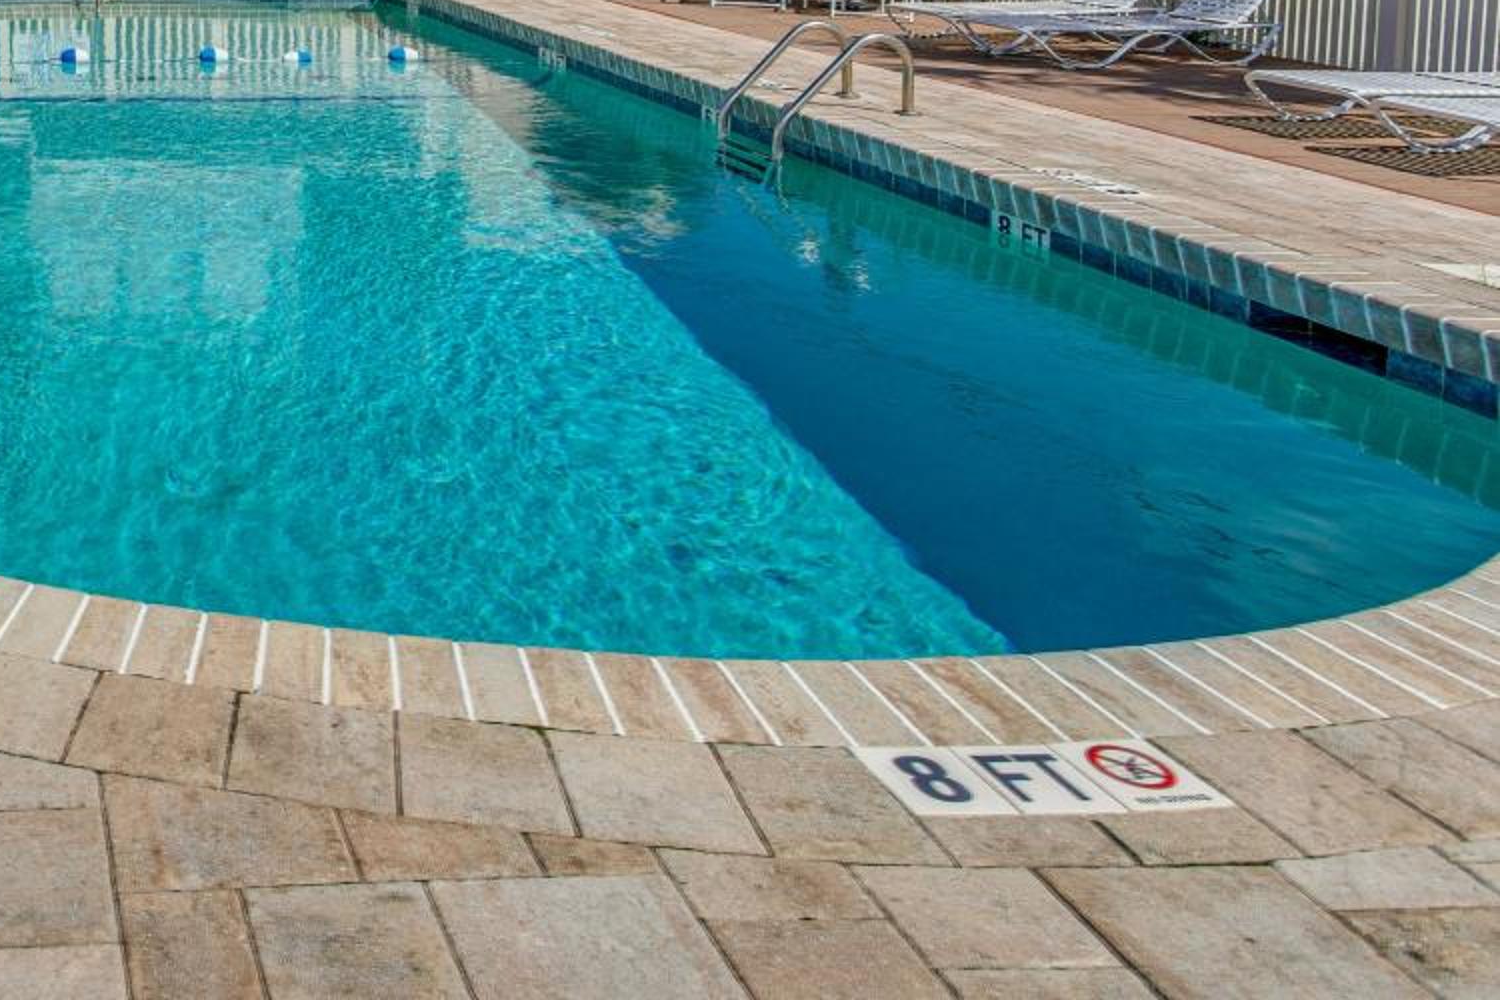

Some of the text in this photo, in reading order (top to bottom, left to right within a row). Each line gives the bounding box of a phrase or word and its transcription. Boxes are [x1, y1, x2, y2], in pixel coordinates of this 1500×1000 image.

[998, 215, 1047, 248] 8 FT
[892, 754, 1092, 803] 8 FT
